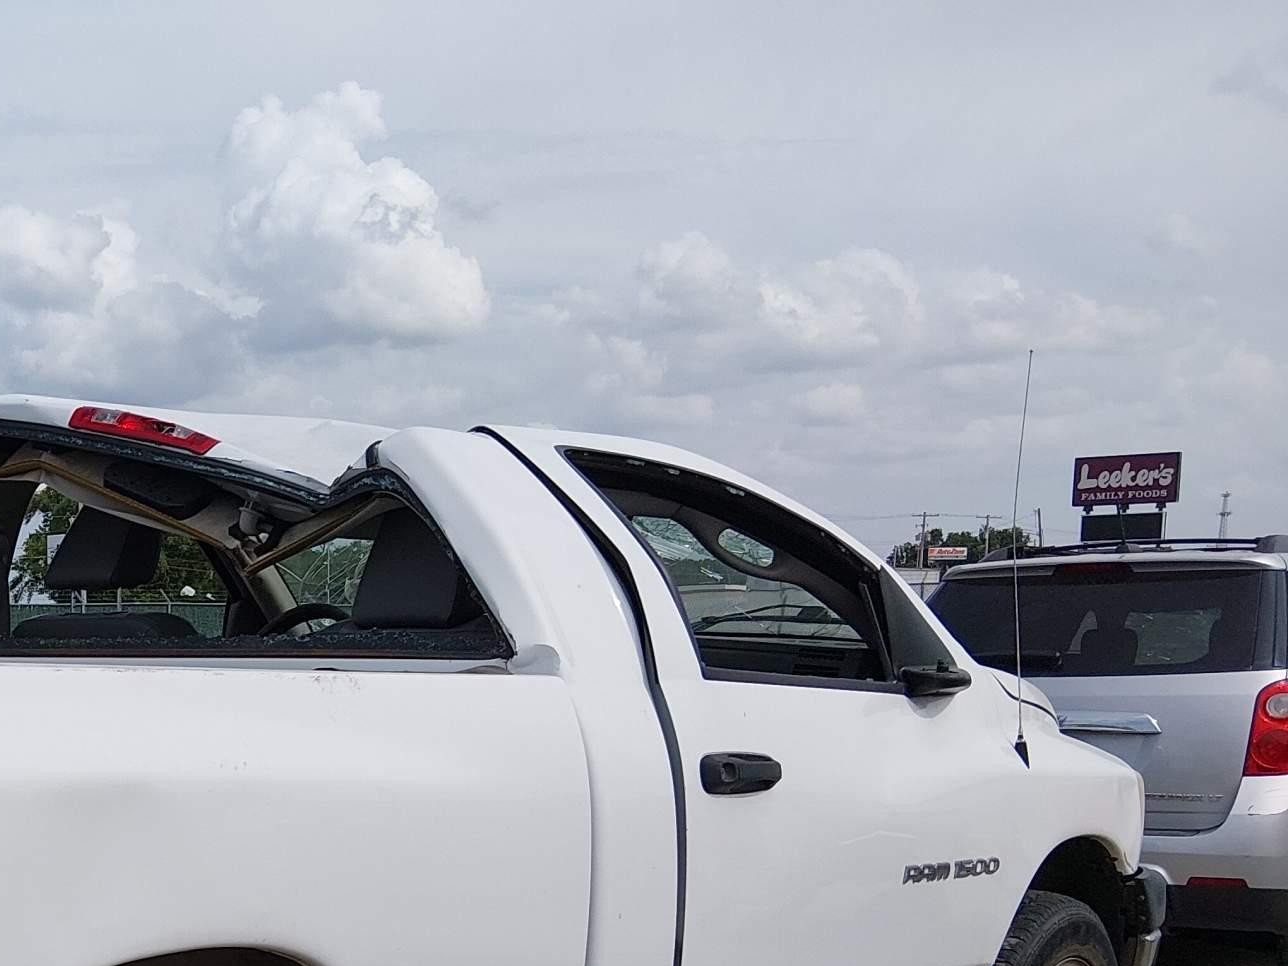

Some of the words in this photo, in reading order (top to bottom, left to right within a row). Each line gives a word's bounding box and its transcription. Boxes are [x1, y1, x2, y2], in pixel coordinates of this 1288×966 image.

[1077, 462, 1174, 490] Leeker's
[1081, 491, 1125, 501] FAMILY
[1128, 489, 1168, 499] FOODS
[902, 862, 951, 885] RAM
[953, 856, 1001, 880] 1500
